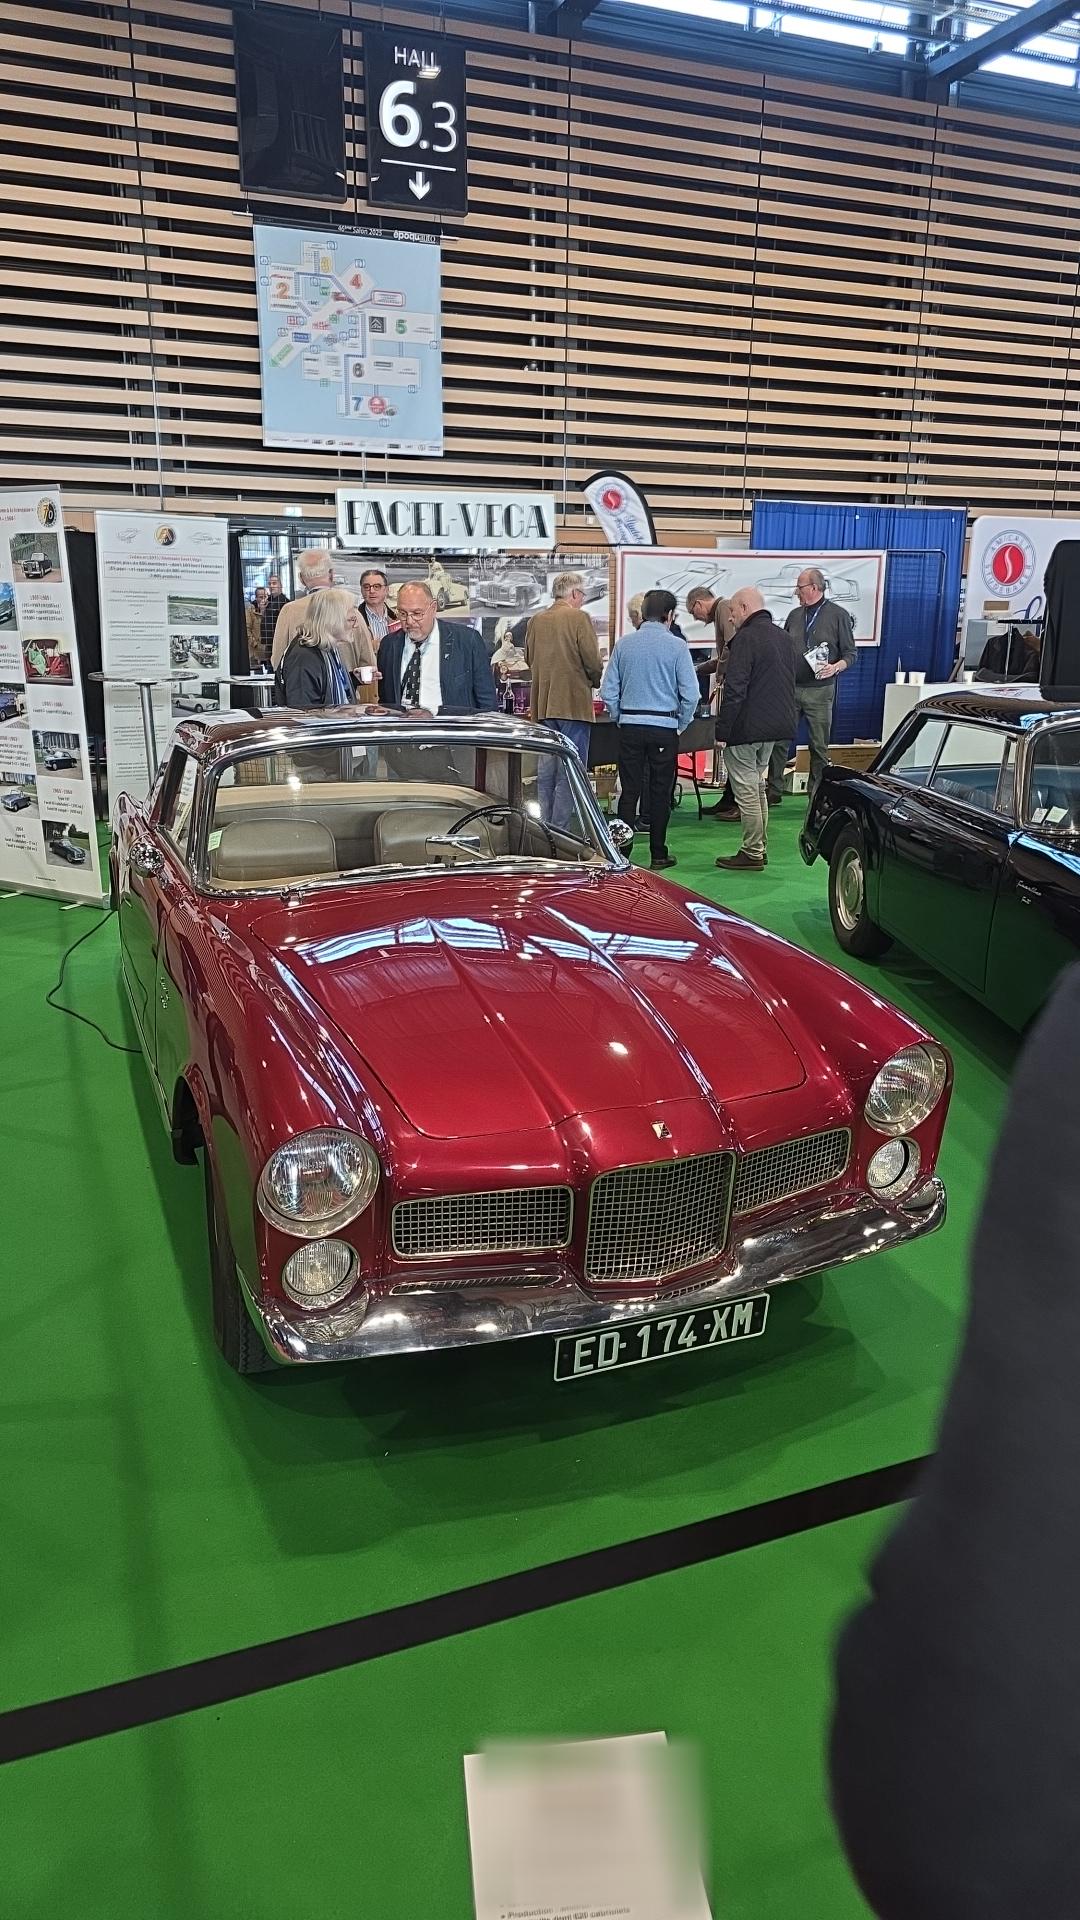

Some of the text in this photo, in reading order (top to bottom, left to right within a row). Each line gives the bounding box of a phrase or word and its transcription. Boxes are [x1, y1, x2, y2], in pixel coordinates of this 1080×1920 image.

[394, 46, 438, 68] HALL
[379, 80, 457, 153] 6.3
[353, 226, 368, 235] Salon
[350, 273, 362, 289] 4
[277, 282, 289, 299] 2
[396, 319, 407, 334] 5
[352, 396, 363, 411] 7
[343, 500, 550, 538] FACEL-VEGA
